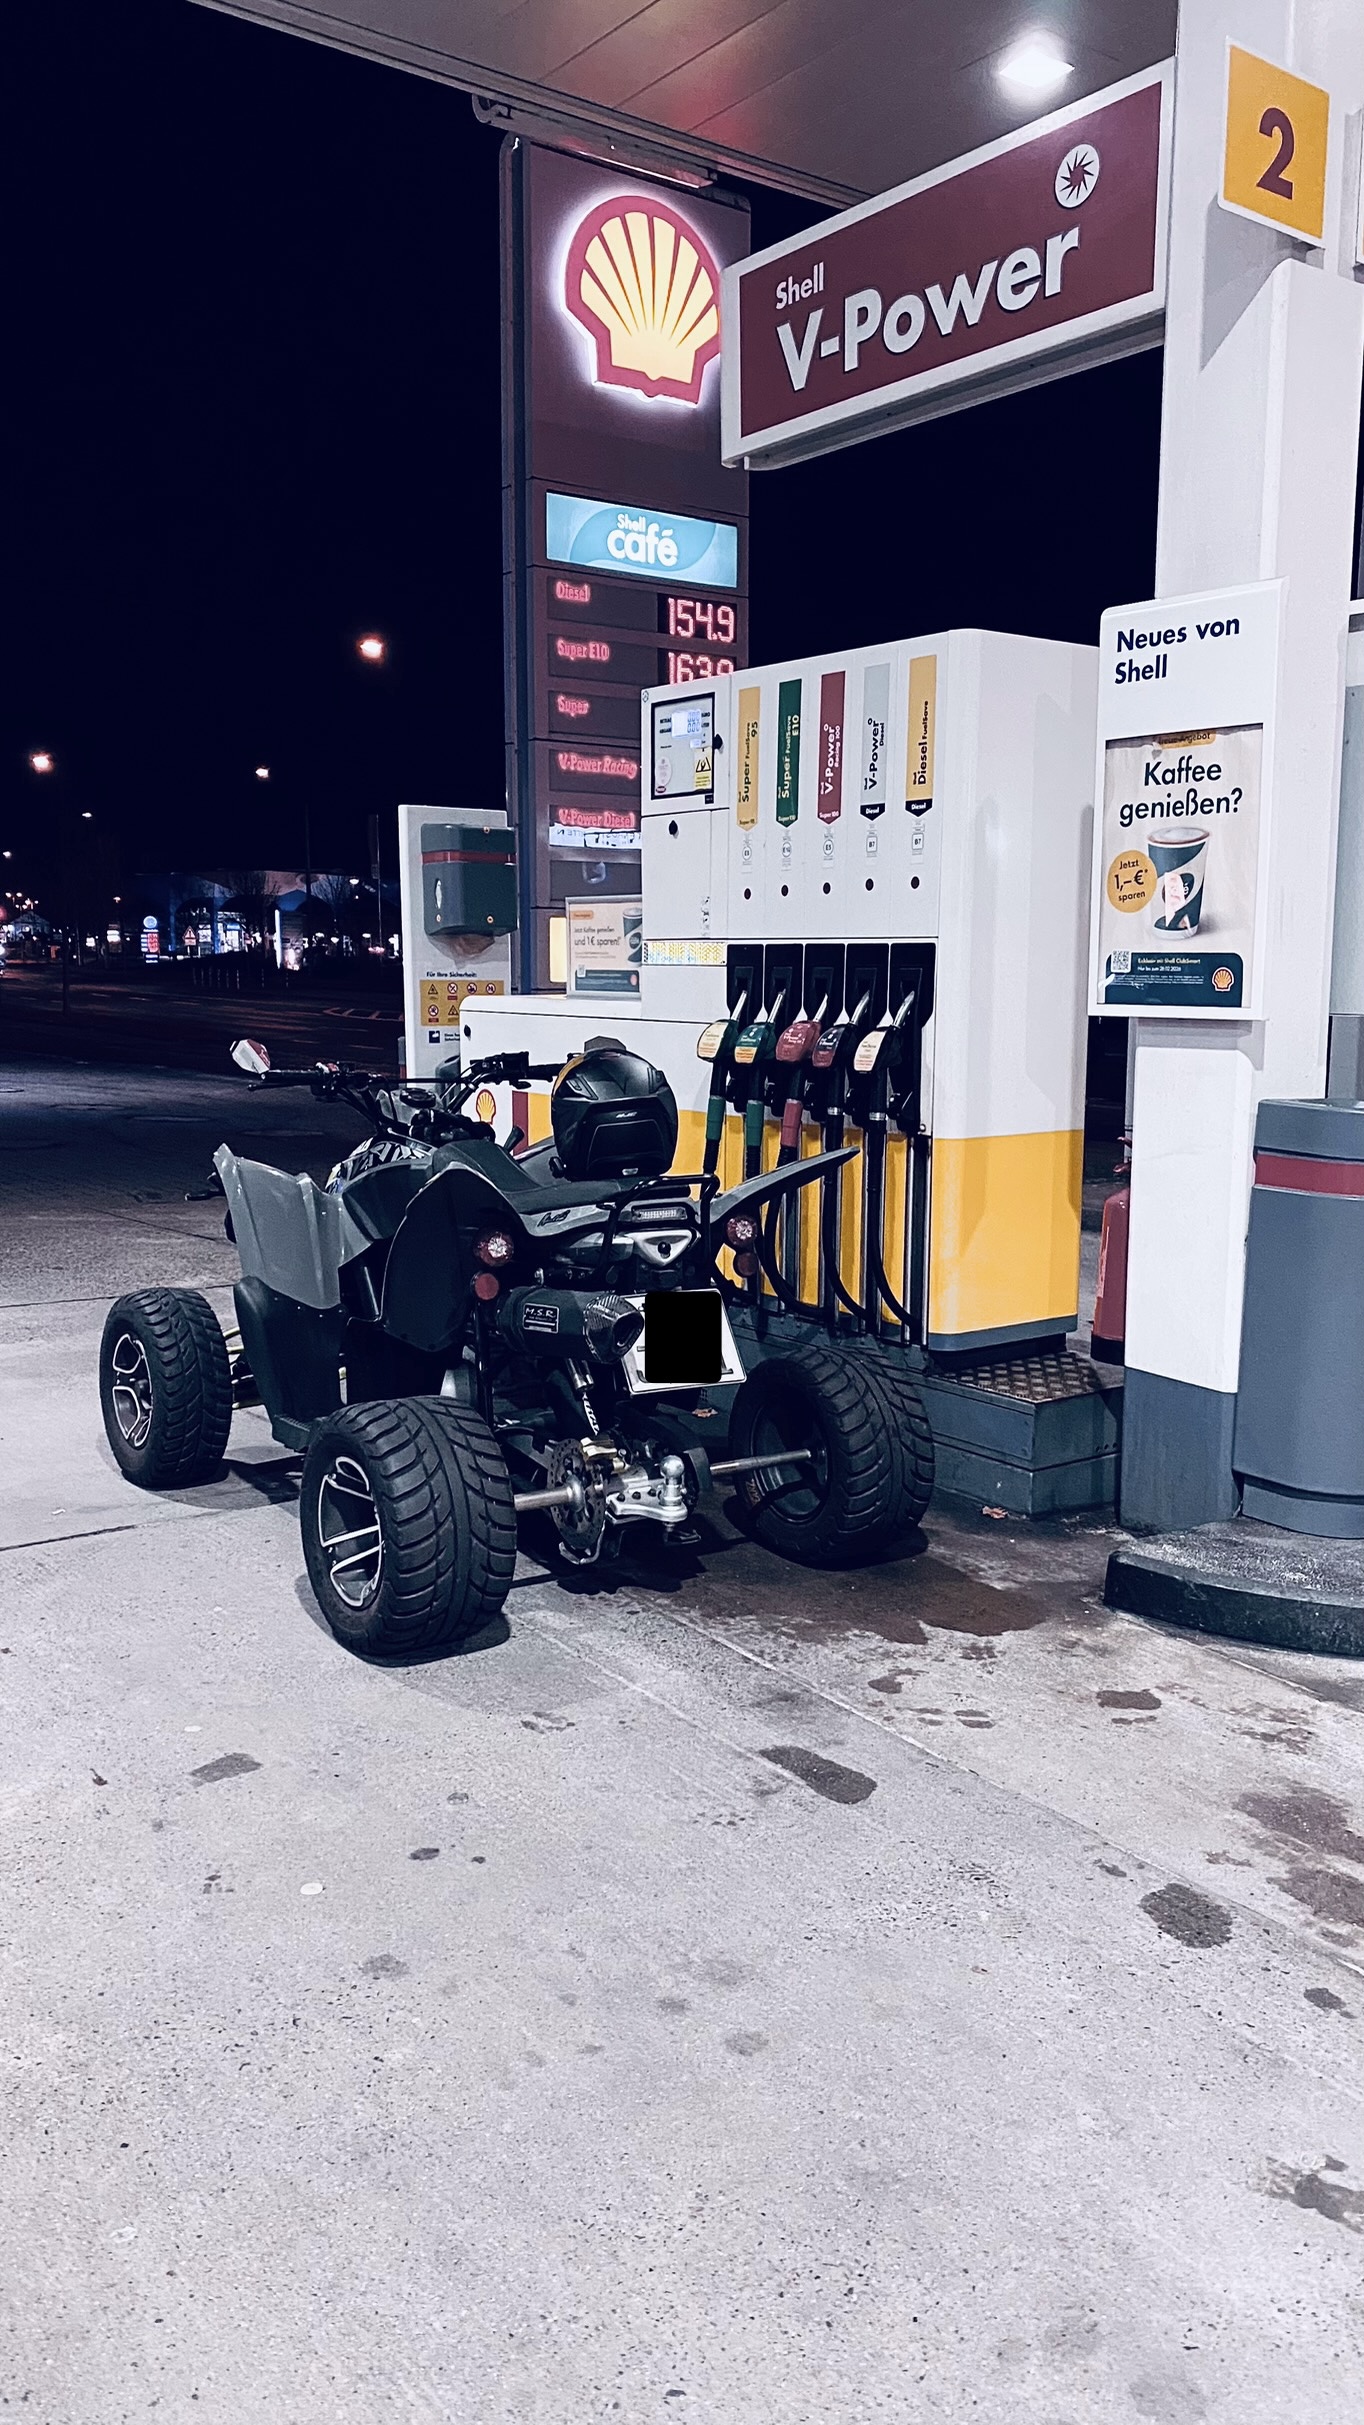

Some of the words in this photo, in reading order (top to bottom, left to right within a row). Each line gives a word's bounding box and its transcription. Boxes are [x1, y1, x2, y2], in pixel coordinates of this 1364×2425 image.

[1256, 107, 1295, 200] 2
[775, 262, 825, 310] Shell
[776, 225, 1079, 391] V-Power
[617, 513, 646, 532] Shell
[606, 522, 679, 567] café
[556, 581, 590, 602] Diesel
[557, 639, 587, 661] Super
[589, 643, 610, 661] E10
[1117, 626, 1187, 653] Neues
[1196, 618, 1240, 640] von
[1115, 653, 1168, 684] Shell
[557, 695, 589, 718] Super
[751, 721, 758, 738] 95
[558, 752, 601, 772] V-Power
[602, 755, 637, 779] Racing
[824, 726, 835, 794] V-Power
[868, 720, 879, 790] V-Power
[918, 742, 927, 785] Diesel
[1144, 755, 1222, 786] Kaffee
[742, 761, 751, 803] Super
[782, 757, 791, 799] Super
[558, 808, 602, 826] V-Power
[603, 811, 635, 829] Diesel
[1119, 787, 1243, 828] genießen?
[1119, 860, 1140, 870] Jetzt
[1118, 891, 1146, 903] sparen
[574, 936, 585, 946] und
[1176, 957, 1201, 965] ClubSmart
